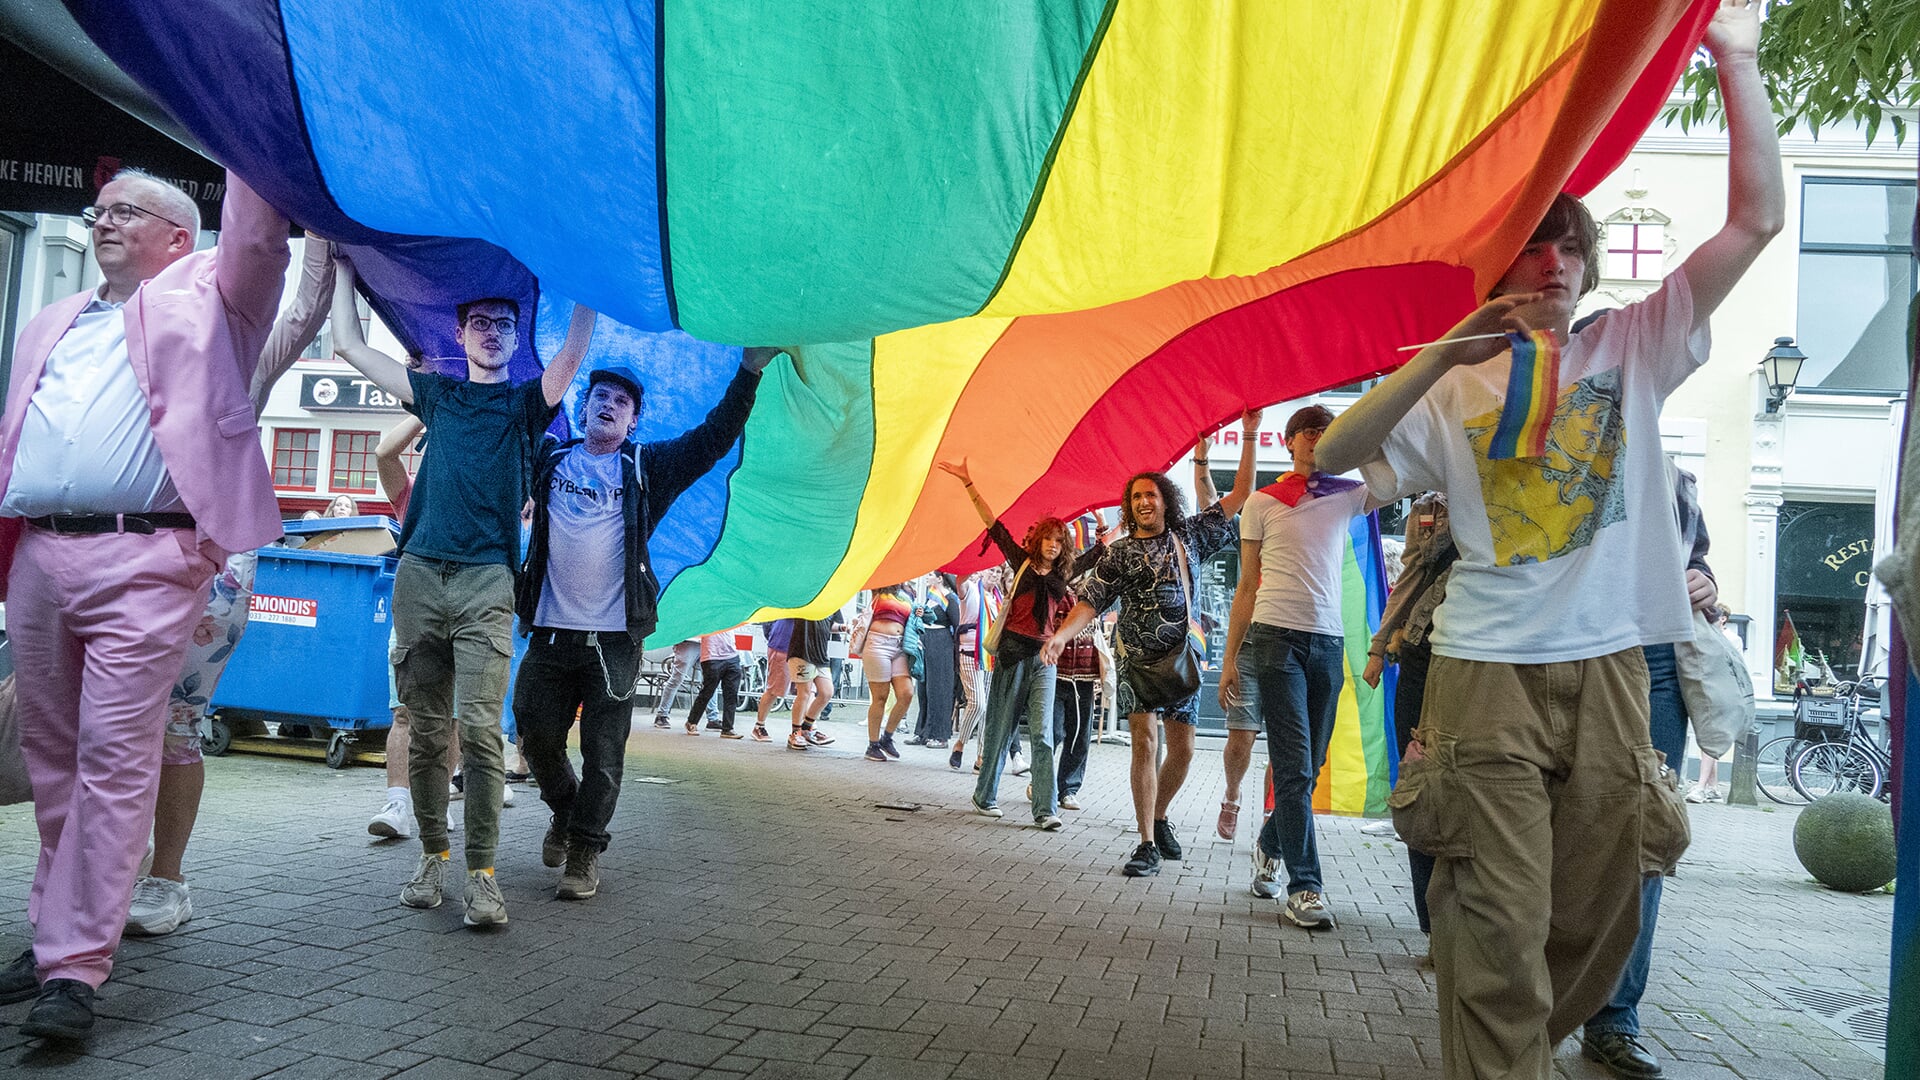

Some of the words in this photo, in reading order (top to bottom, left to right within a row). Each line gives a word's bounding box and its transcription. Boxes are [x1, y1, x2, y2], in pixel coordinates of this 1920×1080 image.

[24, 162, 83, 189] HEAVEN
[350, 379, 401, 407] Tas
[268, 614, 280, 622] 277
